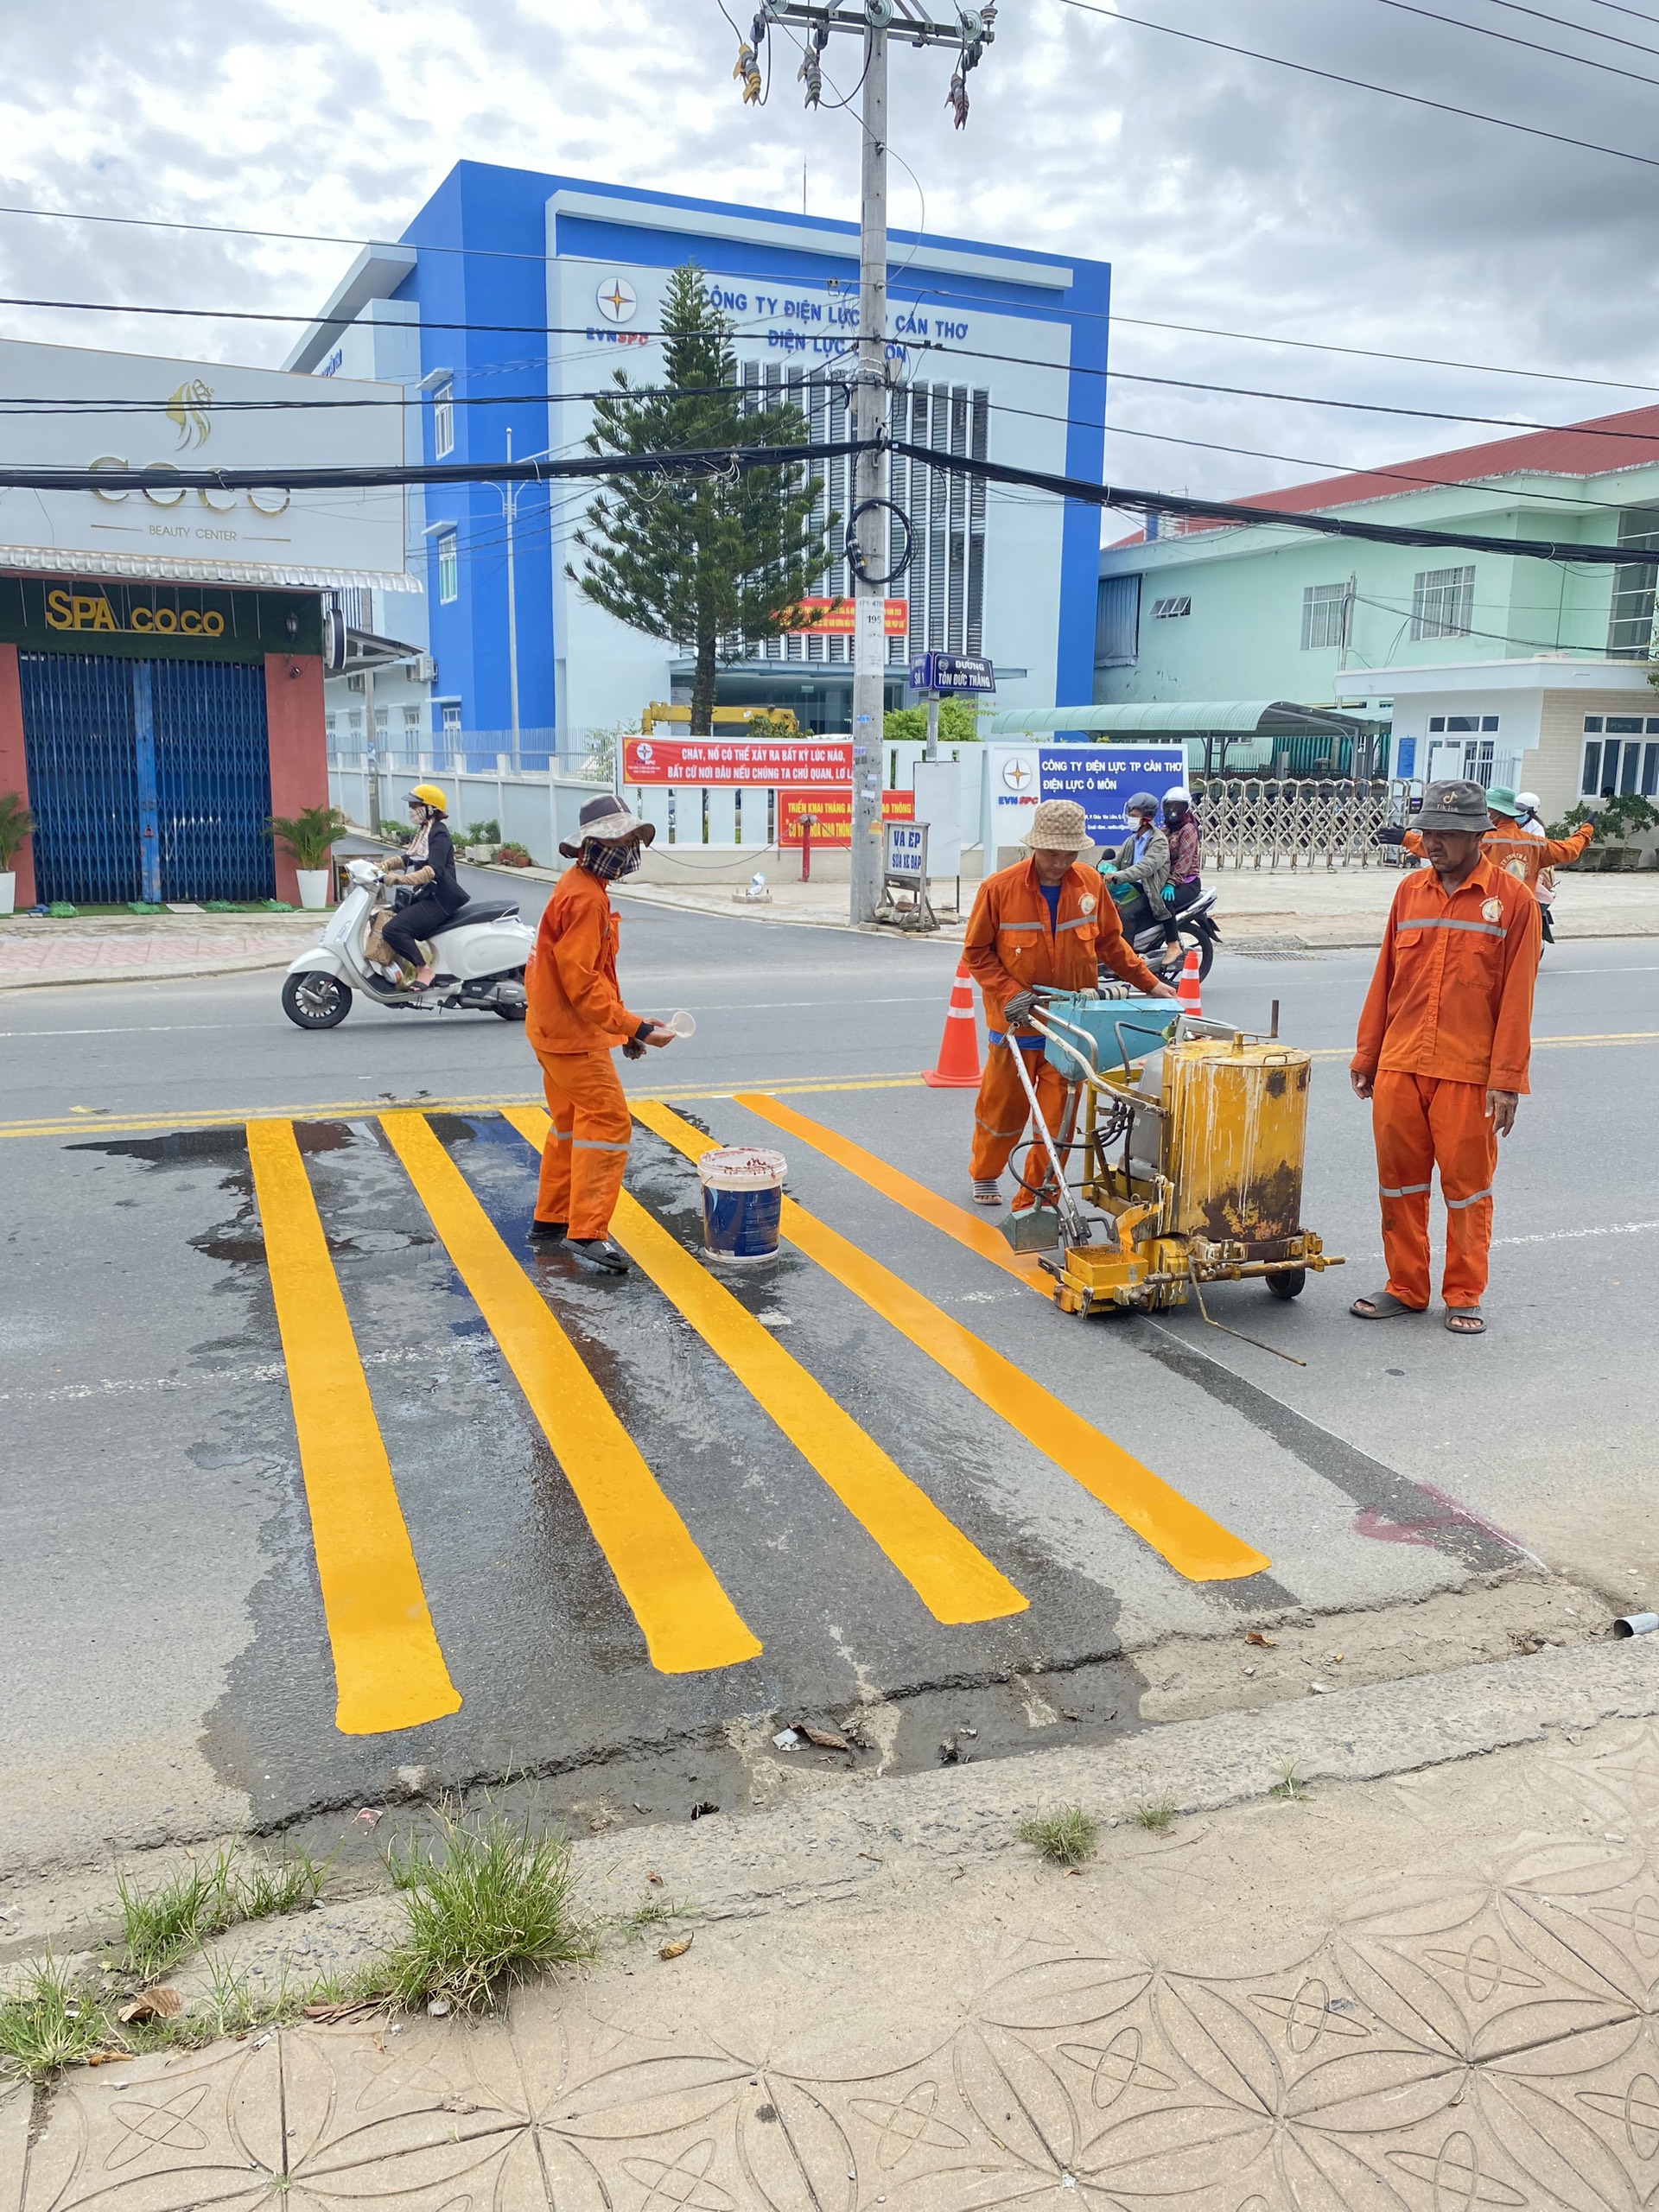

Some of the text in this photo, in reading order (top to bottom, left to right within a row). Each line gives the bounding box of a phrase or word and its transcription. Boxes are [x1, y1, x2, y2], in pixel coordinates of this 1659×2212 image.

[703, 285, 747, 311] ÔNG
[755, 296, 779, 315] TY
[784, 300, 821, 325] ĐIỆN
[935, 321, 969, 340] THƠ
[768, 328, 806, 353] ĐIỆN
[149, 525, 238, 541] BEAUTY CENTER
[46, 589, 225, 635] SPA COCO
[867, 614, 881, 624] 195
[721, 746, 733, 761] CÓ
[769, 749, 780, 761] RA
[781, 747, 797, 761] BẤT
[810, 748, 825, 761] LÚC
[667, 763, 683, 779] BẤT
[752, 765, 779, 779] CHÚNG
[781, 767, 791, 779] TA
[810, 767, 834, 781] QUAN,
[1041, 759, 1183, 774] CÔNG TY ĐIỆN LỰC TP CẦN THƠ
[1043, 778, 1117, 792] ĐIỆN LỰC Ô MÔN
[807, 803, 823, 814] KHAI
